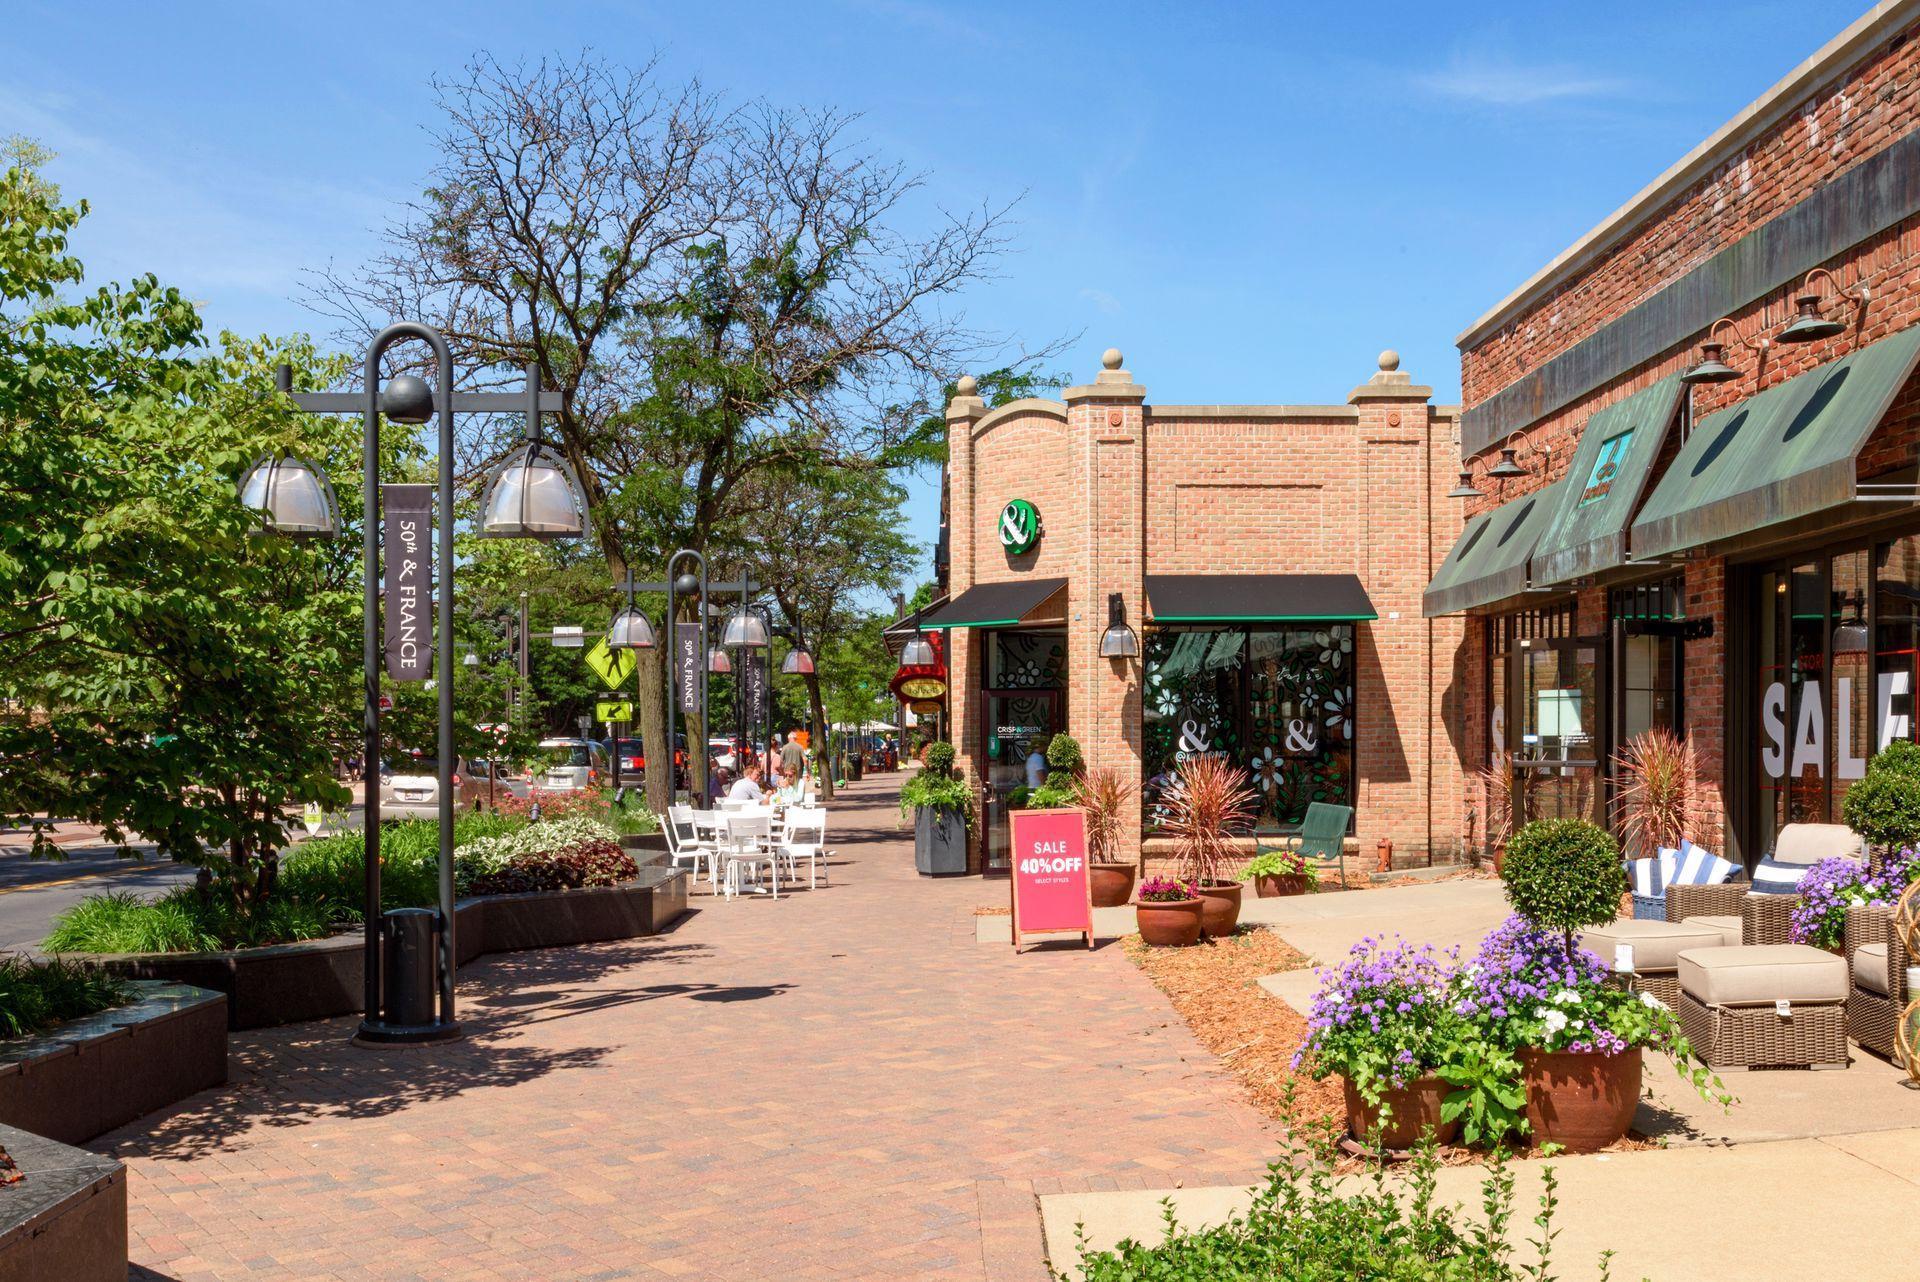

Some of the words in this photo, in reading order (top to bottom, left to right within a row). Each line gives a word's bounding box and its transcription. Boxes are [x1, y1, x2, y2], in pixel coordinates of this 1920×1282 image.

[400, 520, 418, 554] 50th
[399, 559, 418, 581] &
[400, 585, 417, 668] FRANCE
[684, 639, 694, 656] 50th
[684, 657, 694, 668] &
[684, 669, 694, 708] FRANCE
[753, 680, 761, 688] &
[753, 688, 761, 717] FRANCE
[1762, 671, 1909, 779] SALE
[1034, 841, 1067, 854] SALE
